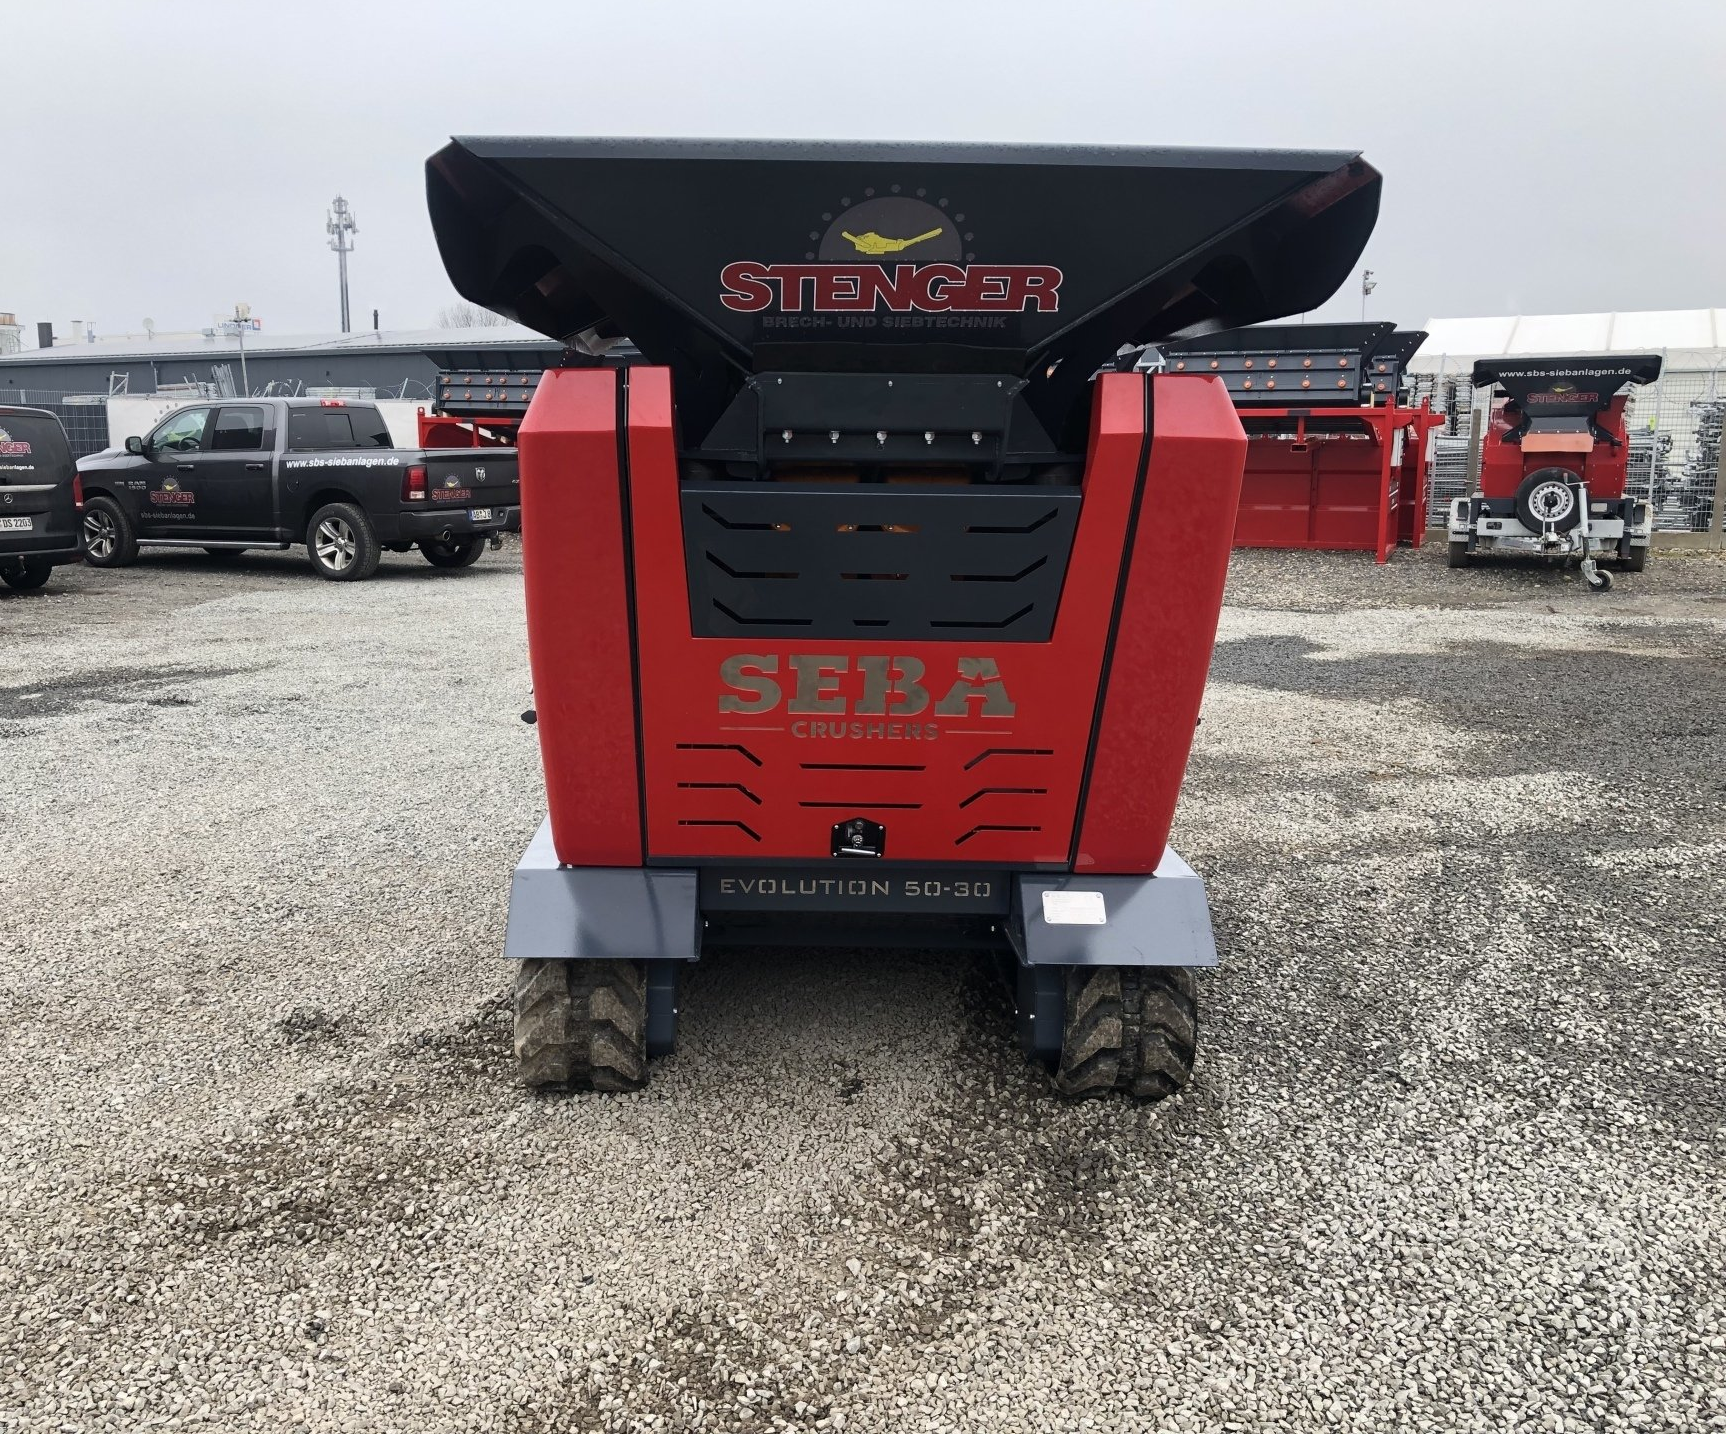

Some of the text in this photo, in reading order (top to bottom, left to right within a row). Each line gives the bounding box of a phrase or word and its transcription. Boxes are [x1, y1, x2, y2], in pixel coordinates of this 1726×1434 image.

[720, 261, 1063, 313] STENGER
[762, 316, 1006, 329] BRECH- UND SIEBTECHNIK
[1499, 367, 1632, 378] www.sbs-siebanlagen.de
[1526, 392, 1599, 404] STENGER
[286, 456, 399, 468] www.sbs-siebanlagen.de
[150, 490, 195, 504] STENGER
[431, 488, 472, 501] STENGER
[718, 653, 1016, 718] SEBA
[790, 720, 940, 741] CRUSHERS
[720, 878, 991, 897] EVOLUTION 50-30
